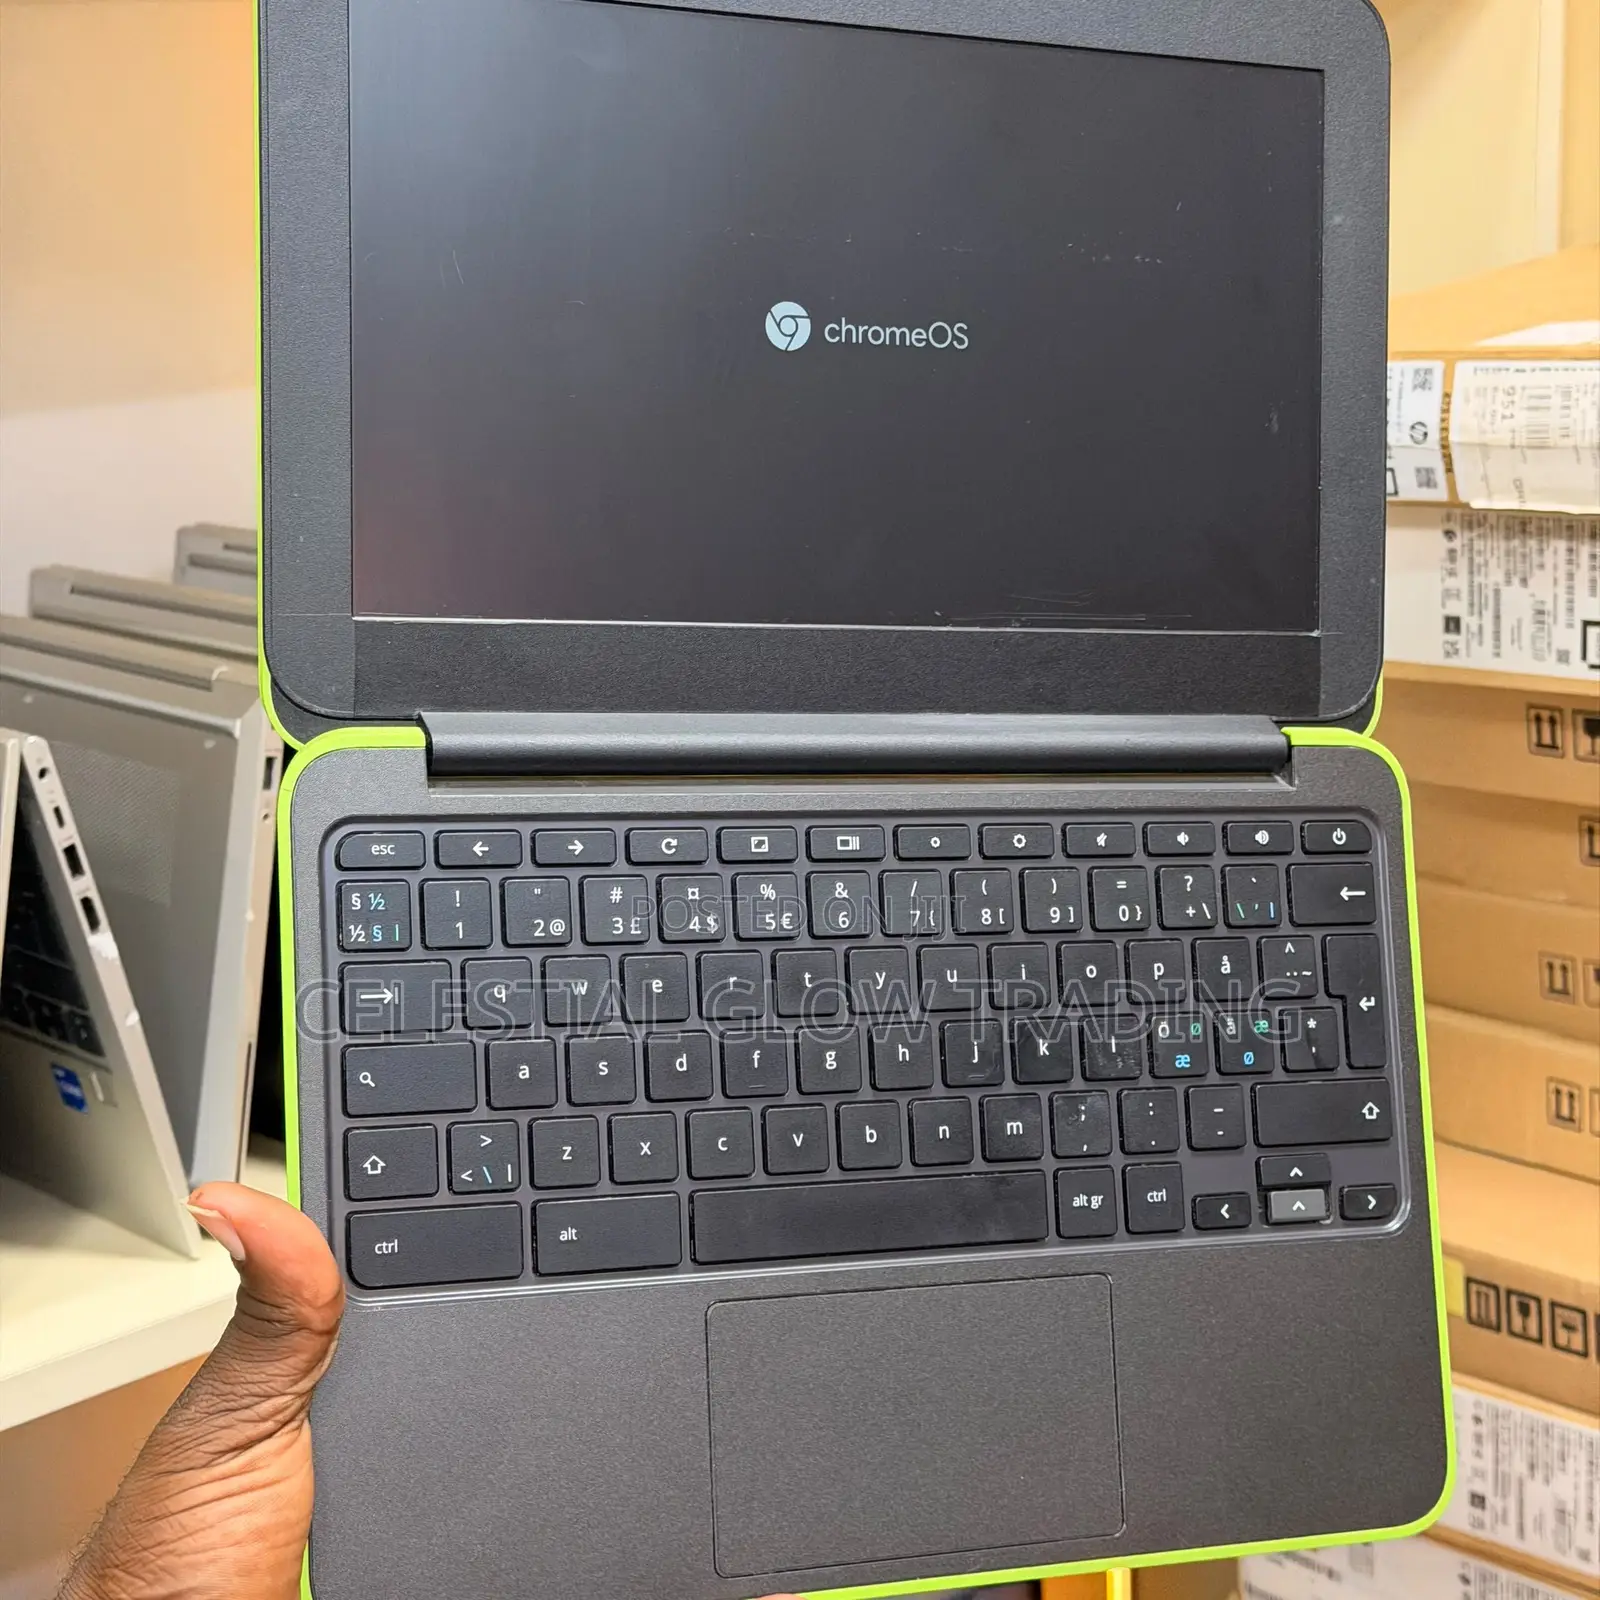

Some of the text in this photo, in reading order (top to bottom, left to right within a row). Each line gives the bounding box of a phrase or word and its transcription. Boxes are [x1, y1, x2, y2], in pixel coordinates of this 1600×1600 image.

[824, 317, 969, 350] chromeOS
[372, 845, 395, 854] esc
[835, 882, 848, 898] &
[1185, 876, 1192, 891] ?
[610, 887, 622, 903] #
[760, 884, 775, 900] %
[534, 919, 565, 936] 2 @
[613, 917, 641, 934] 3 £
[766, 913, 793, 930] 5 €
[839, 912, 849, 928] 6
[456, 922, 462, 938] 1
[1086, 965, 1096, 978] o
[1154, 963, 1164, 980] p
[1221, 956, 1230, 973] å
[729, 977, 737, 990] r
[804, 972, 812, 987] t
[876, 972, 885, 989] y
[947, 970, 957, 982] u
[494, 985, 505, 1002] q
[572, 980, 588, 995] w
[652, 980, 662, 992] e
[899, 1044, 909, 1061] h
[1039, 1039, 1049, 1055] k
[676, 1054, 686, 1071] d
[753, 1051, 760, 1068] f
[826, 1052, 836, 1069] g
[1175, 1055, 1190, 1067] æ
[519, 1066, 529, 1079] a
[599, 1062, 608, 1075] s
[866, 1126, 876, 1142] b
[939, 1126, 949, 1138] n
[1007, 1122, 1022, 1135] m
[718, 1138, 727, 1150] c
[793, 1134, 803, 1146] v
[563, 1147, 572, 1159] z
[640, 1142, 651, 1155] x
[1073, 1194, 1103, 1209] alt gr
[1147, 1189, 1166, 1202] ctrl
[560, 1227, 577, 1240] alt
[375, 1239, 397, 1254] ctrl
